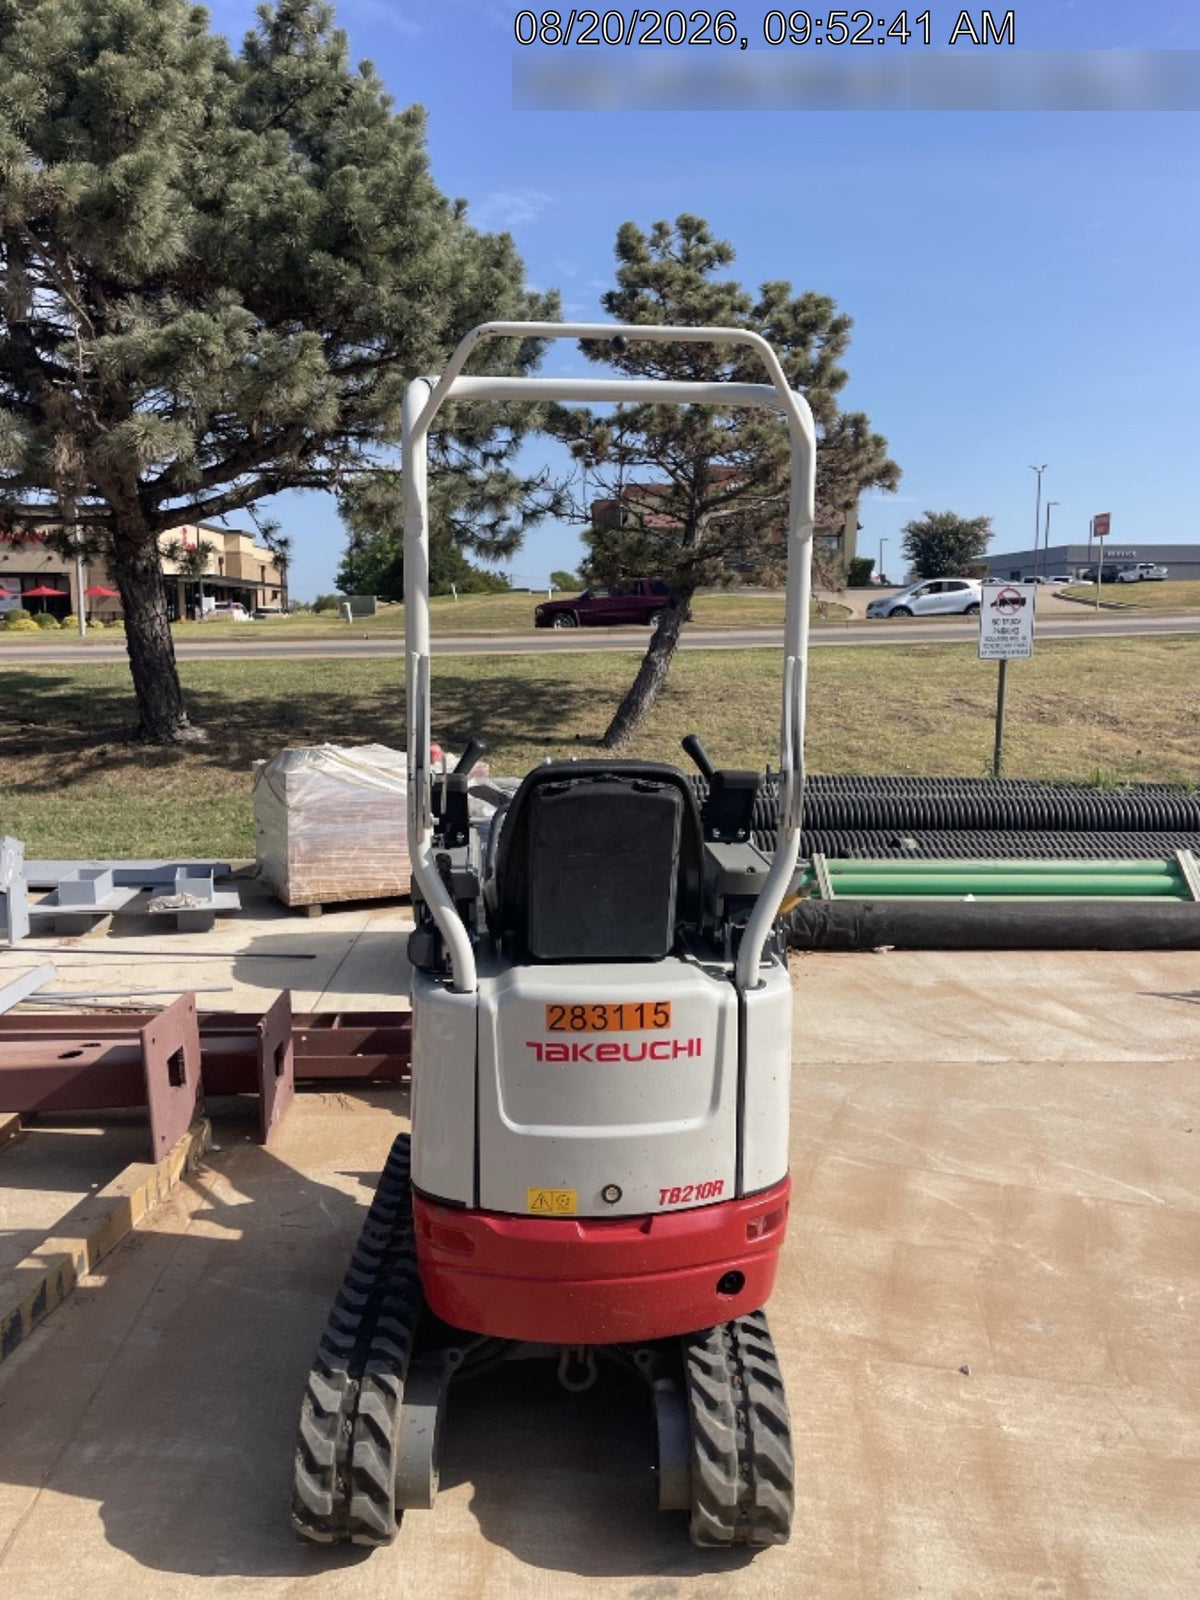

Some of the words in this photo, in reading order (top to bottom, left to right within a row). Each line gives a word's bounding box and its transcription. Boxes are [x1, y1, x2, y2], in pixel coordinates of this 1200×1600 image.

[549, 1002, 670, 1031] 283115
[526, 1038, 701, 1062] TAKEUCHI
[658, 1180, 724, 1205] TB210R
